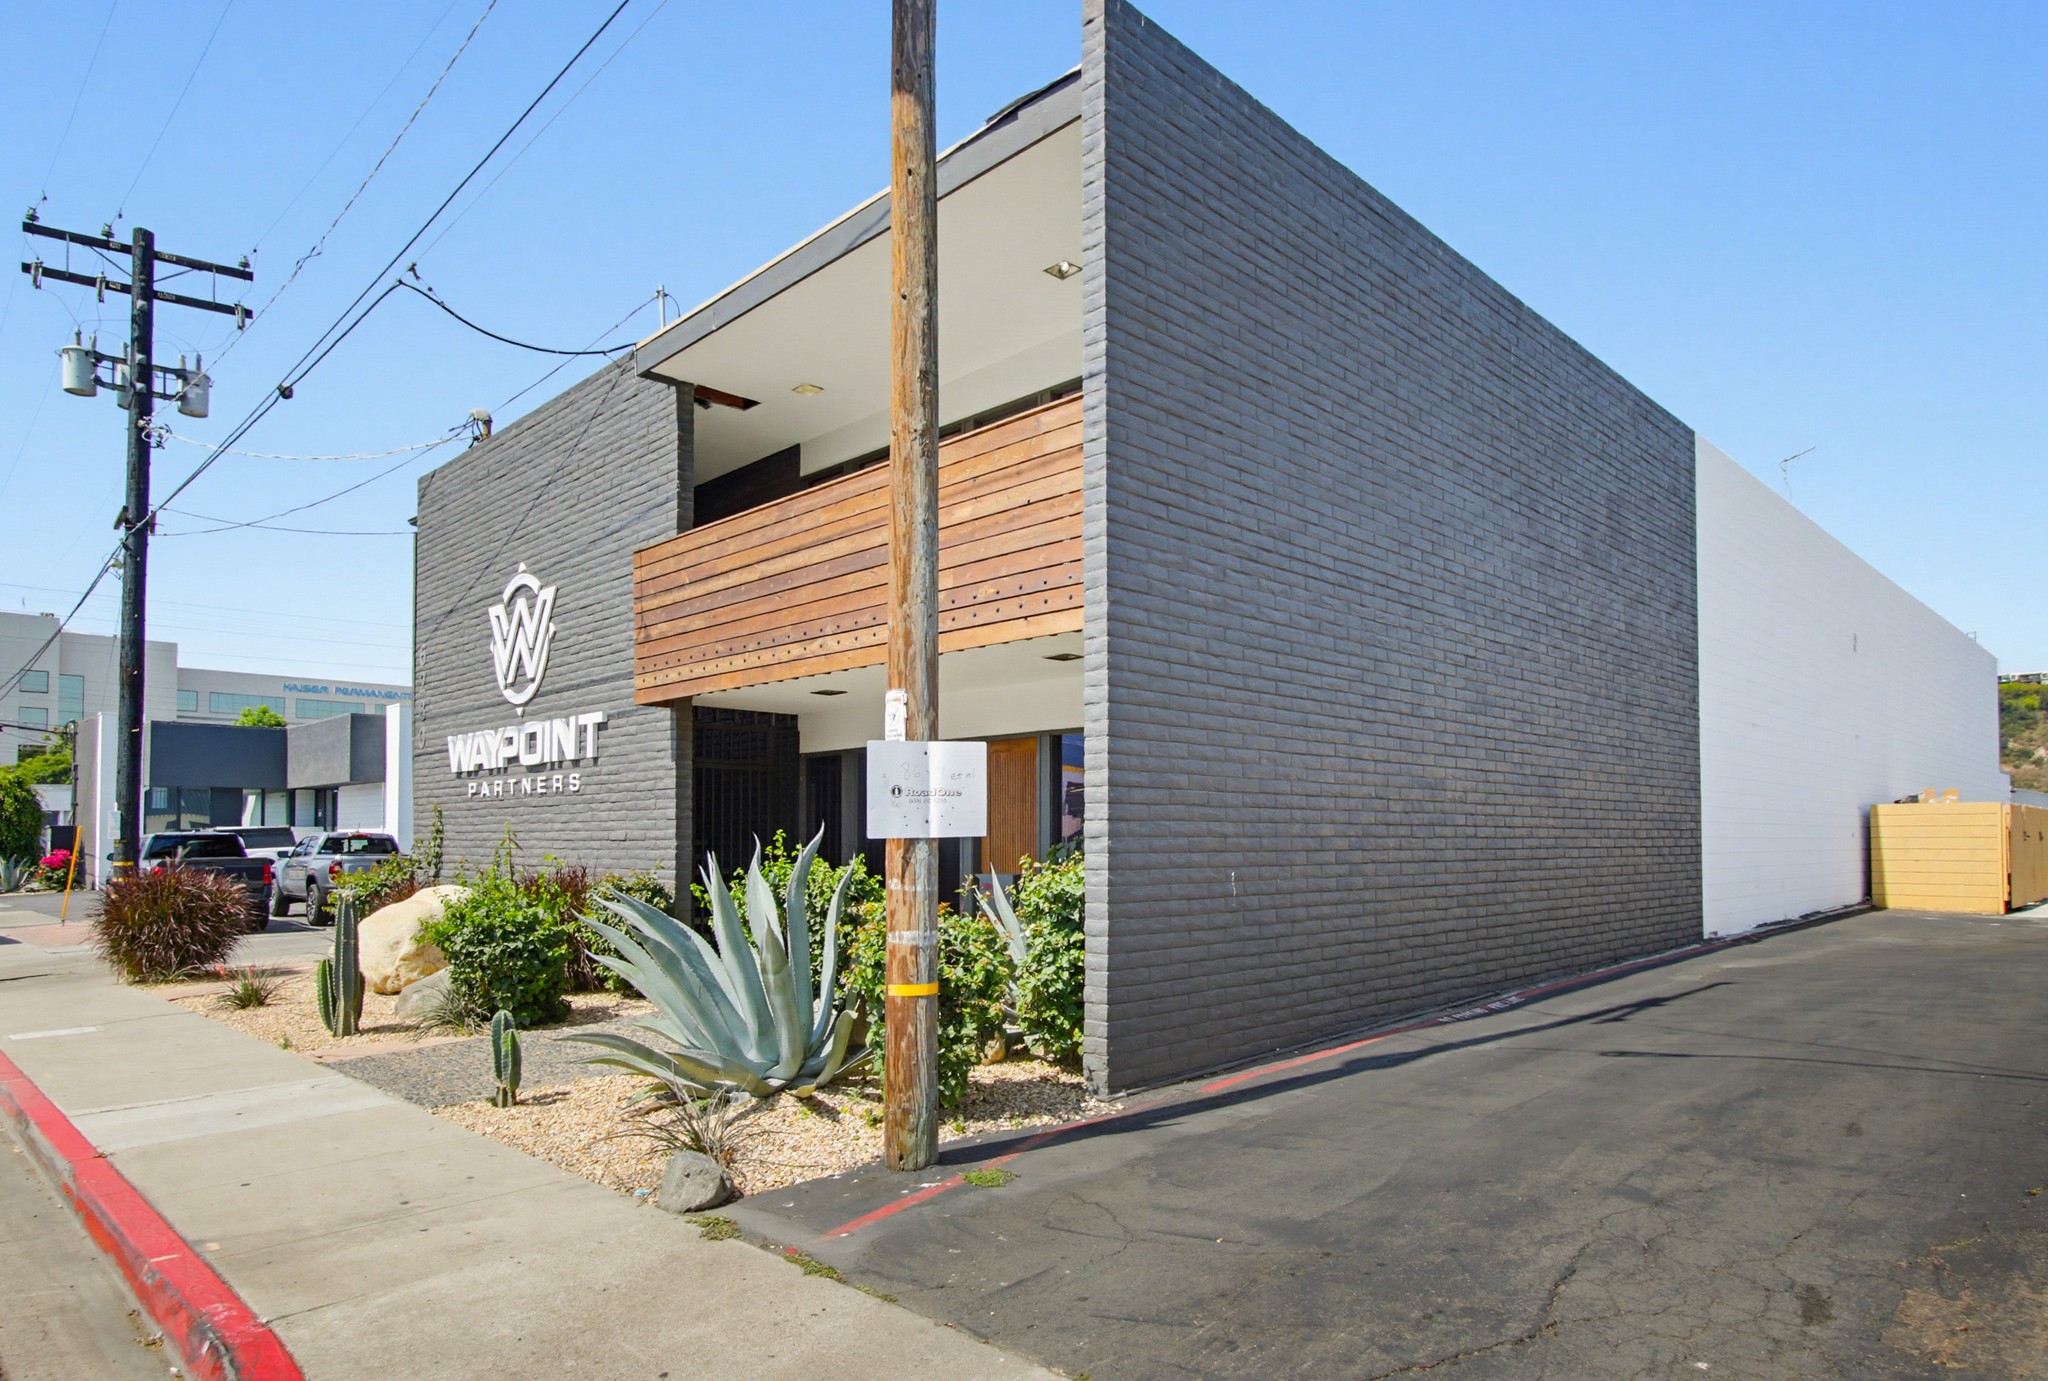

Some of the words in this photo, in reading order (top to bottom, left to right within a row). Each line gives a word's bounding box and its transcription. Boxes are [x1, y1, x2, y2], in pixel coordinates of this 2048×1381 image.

[283, 683, 329, 695] KAISER
[447, 711, 606, 773] WAYPOINT
[468, 773, 582, 799] PARTNERS
